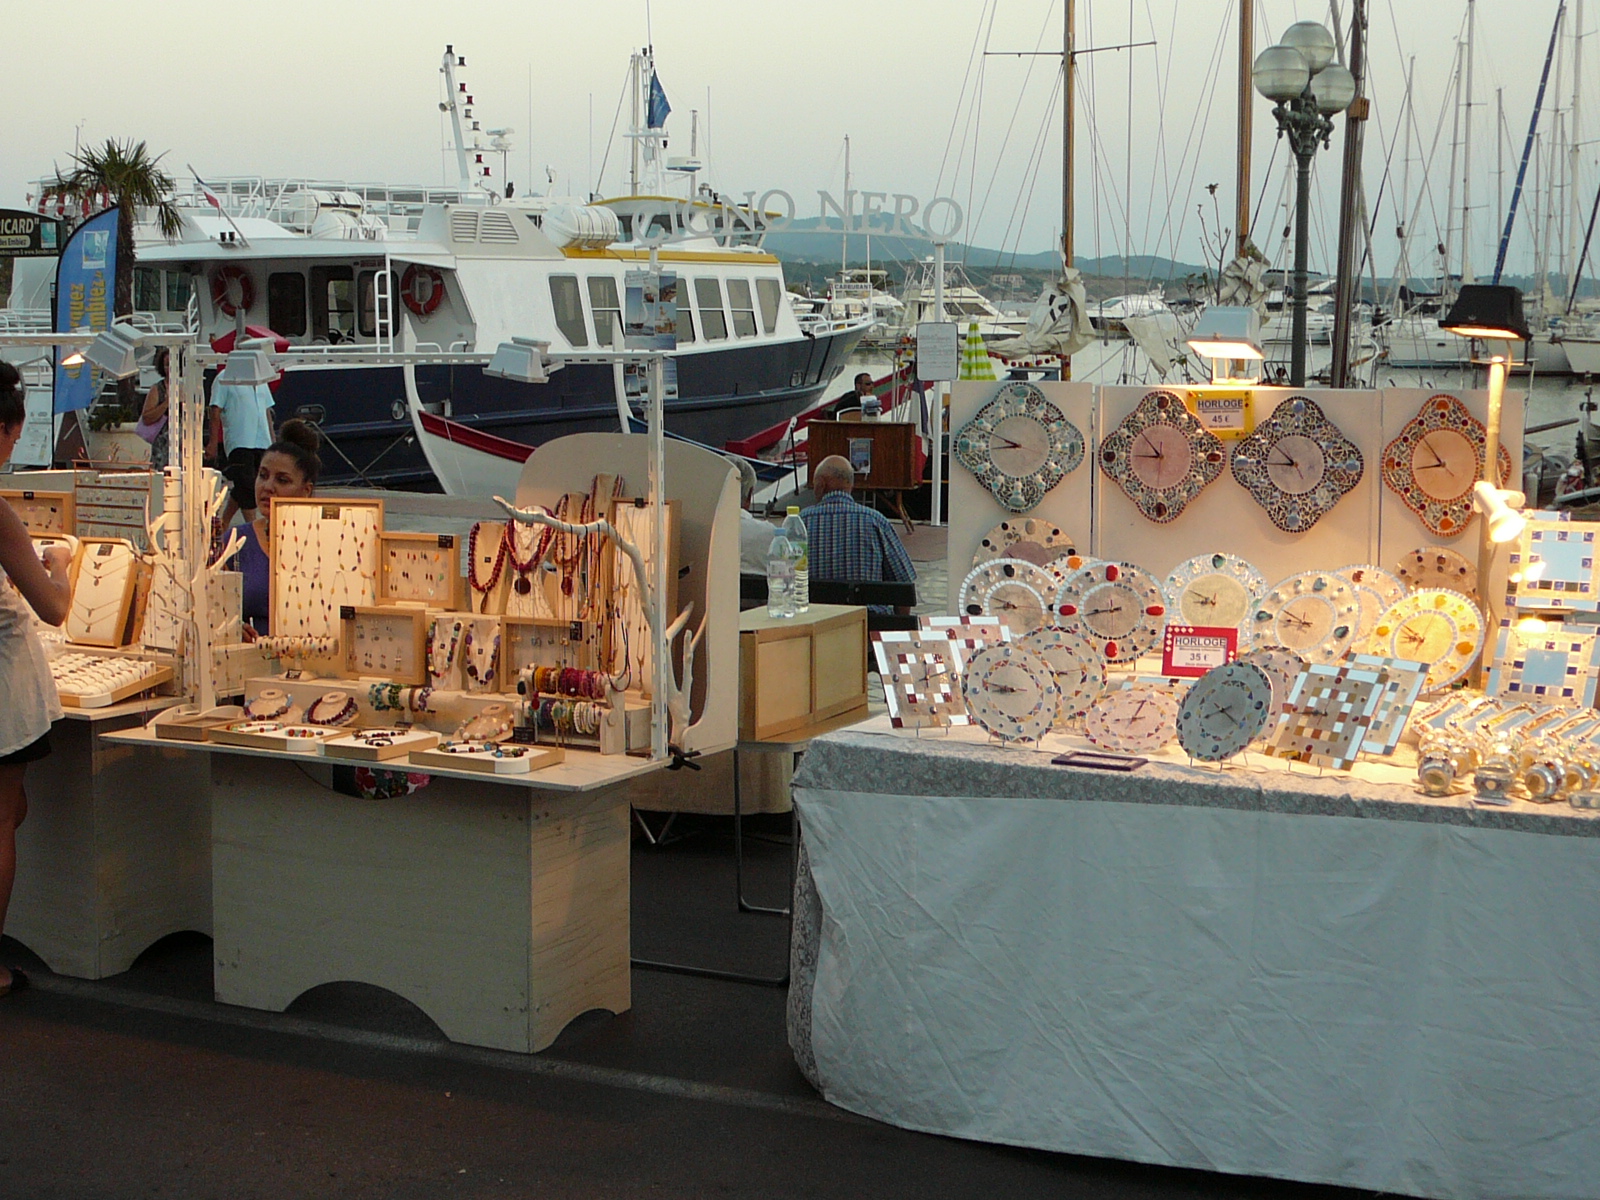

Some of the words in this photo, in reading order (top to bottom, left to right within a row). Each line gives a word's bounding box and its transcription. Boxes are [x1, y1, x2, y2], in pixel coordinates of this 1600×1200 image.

[631, 189, 796, 246] CIGNO
[816, 189, 964, 242] NERO
[1197, 399, 1243, 409] HORLOGE
[1212, 415, 1223, 423] 45
[1175, 637, 1226, 647] HORLOGE
[1190, 653, 1201, 661] 35
